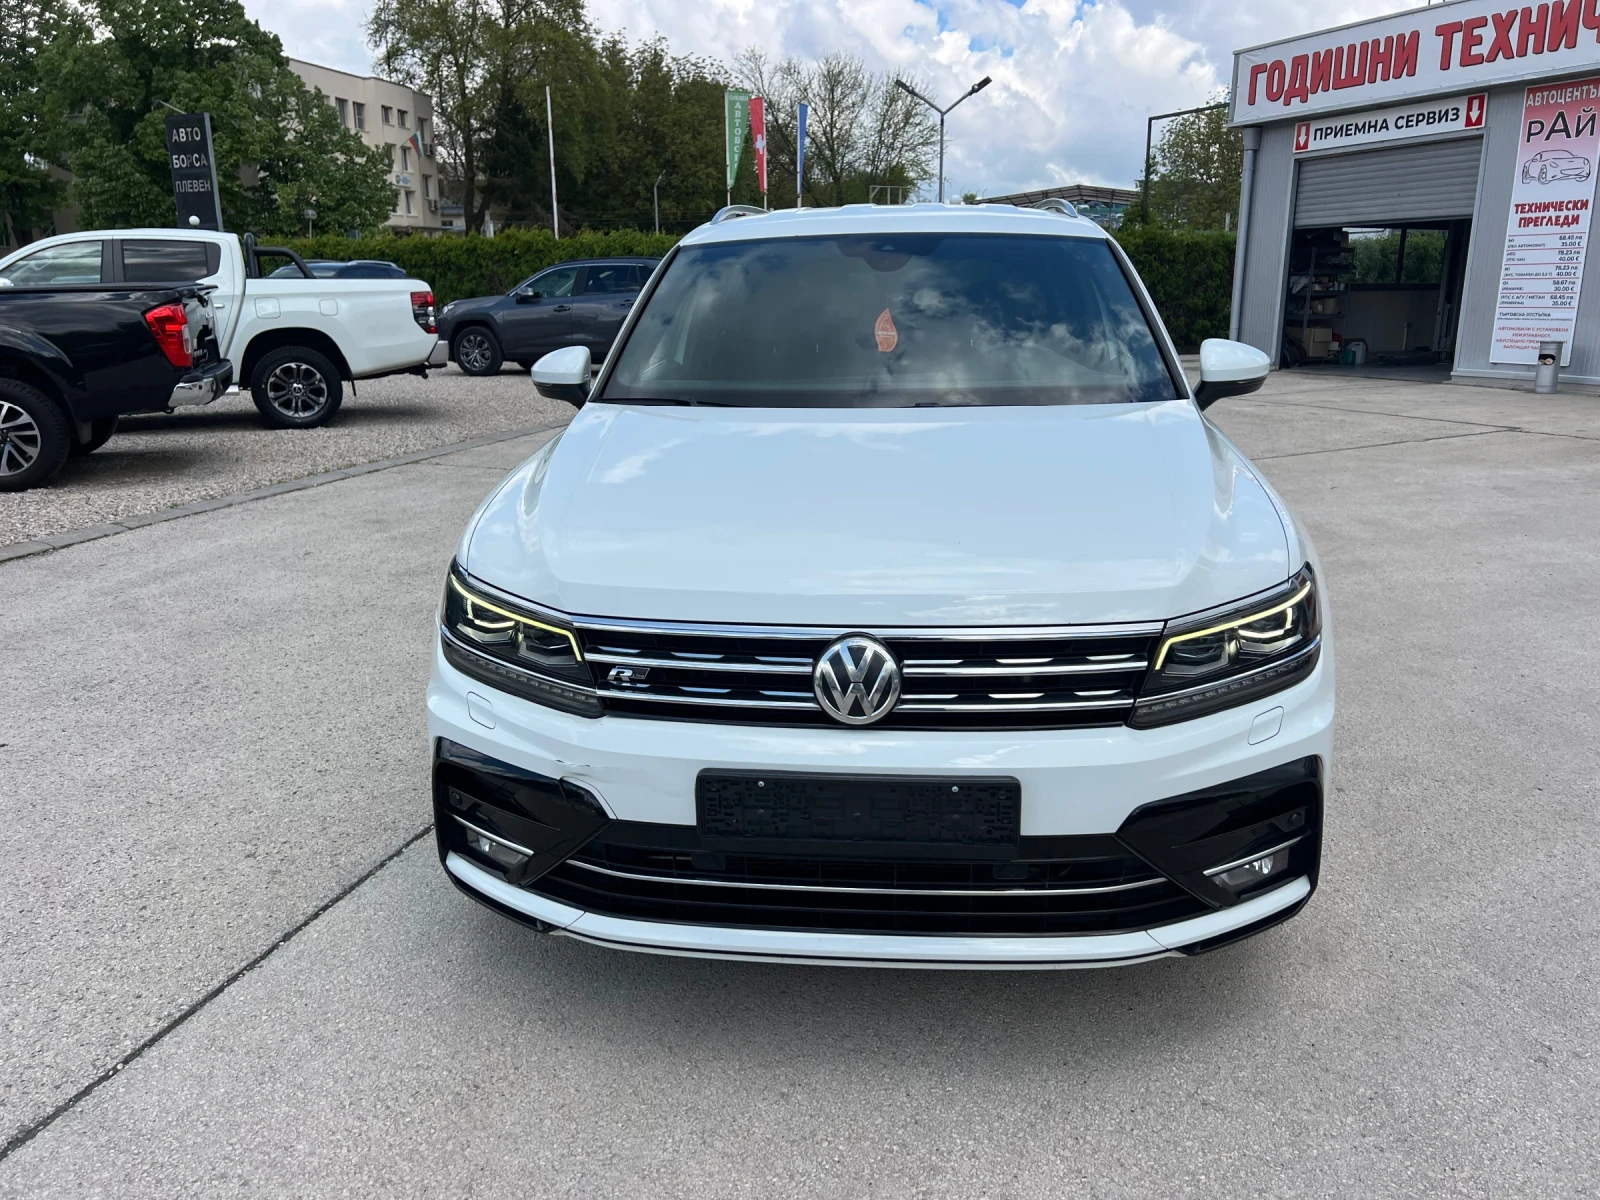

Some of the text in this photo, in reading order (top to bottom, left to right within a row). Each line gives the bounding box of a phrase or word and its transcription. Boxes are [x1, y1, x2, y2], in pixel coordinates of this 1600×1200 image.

[1248, 30, 1420, 106] ГОДИШНИ
[1313, 107, 1461, 142] ПРИЕМНА СЕРВИЗ
[1526, 107, 1598, 143] РАЙ
[172, 127, 201, 143] АВТО
[172, 153, 208, 169] БОРСА
[175, 179, 211, 193] ПЛЕВЕН
[1514, 199, 1589, 214] ТЕХНИЧЕСКИ
[1518, 214, 1580, 228] ПРЕГЛЕДИ
